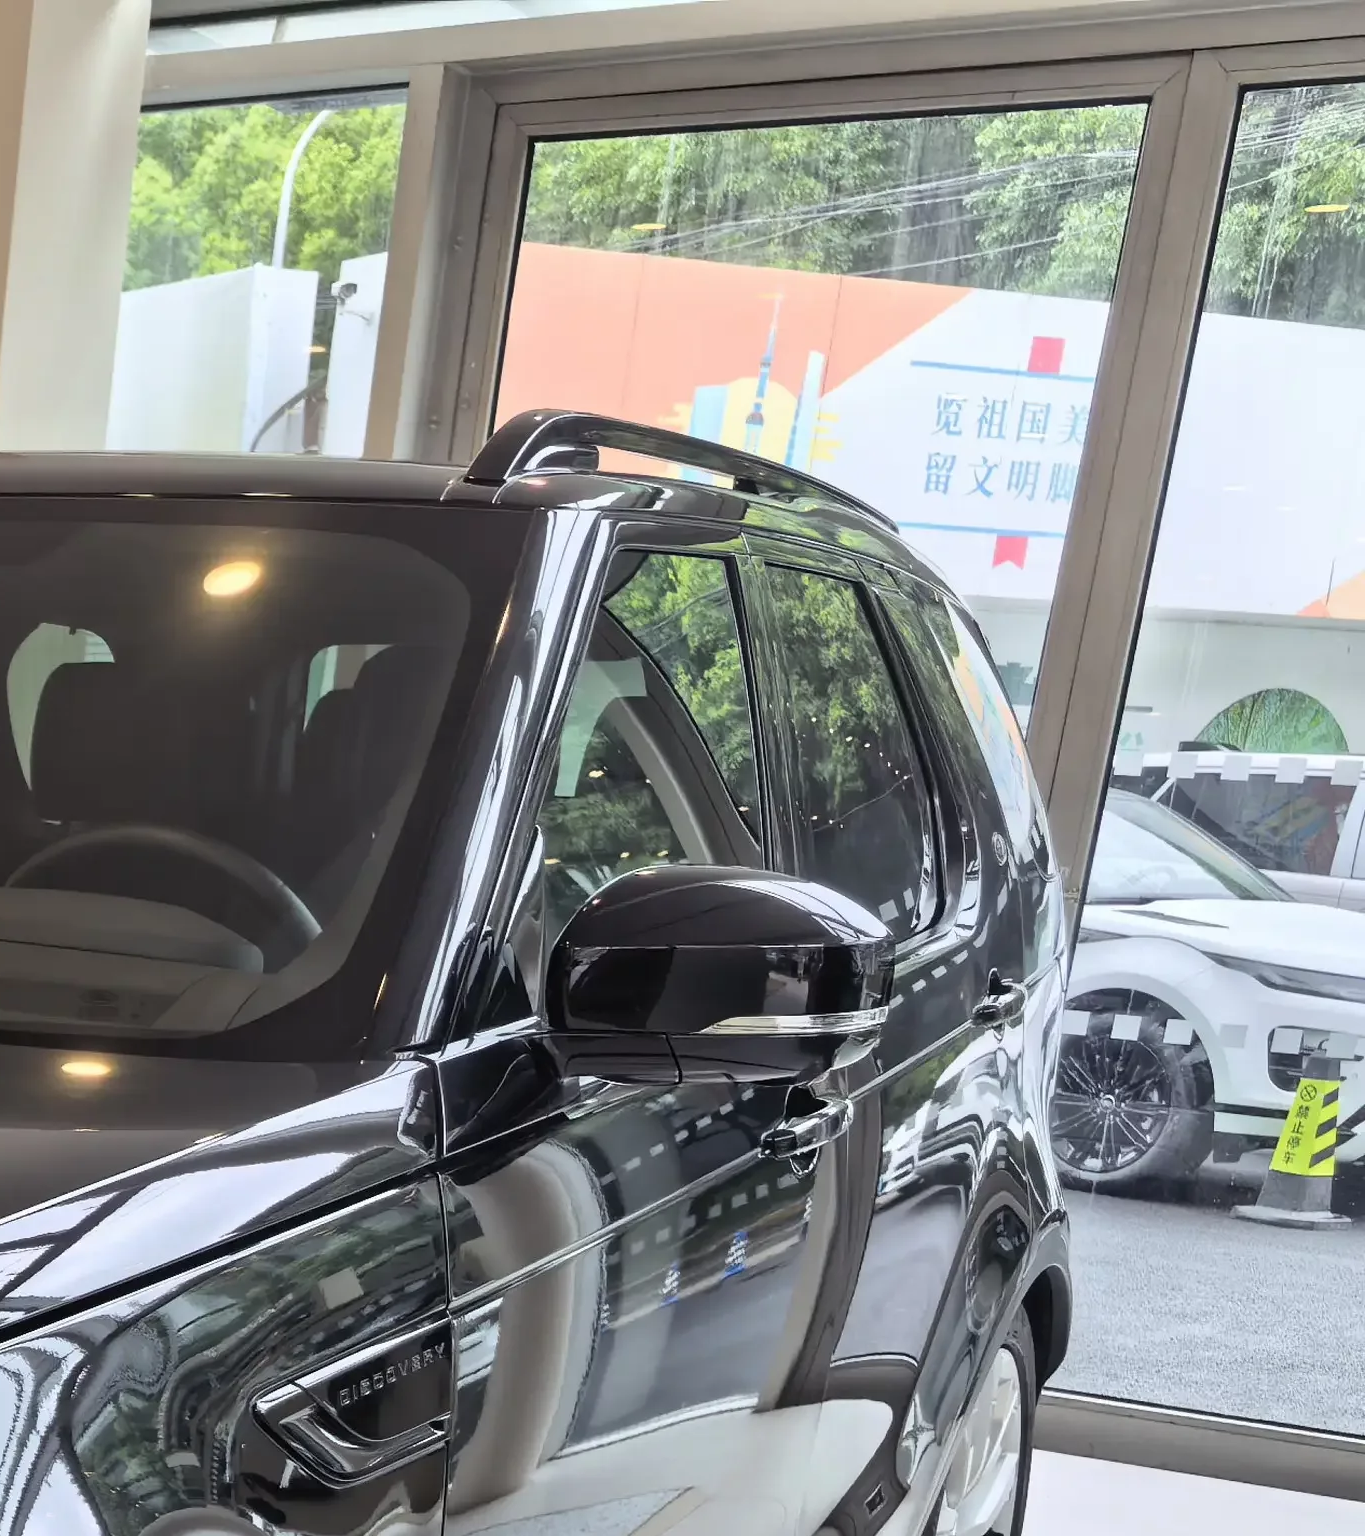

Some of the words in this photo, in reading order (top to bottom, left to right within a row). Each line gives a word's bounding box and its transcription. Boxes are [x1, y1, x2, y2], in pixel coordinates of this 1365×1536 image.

[930, 392, 1090, 445] 览祖国美
[339, 1342, 447, 1406] DISCOVERY
